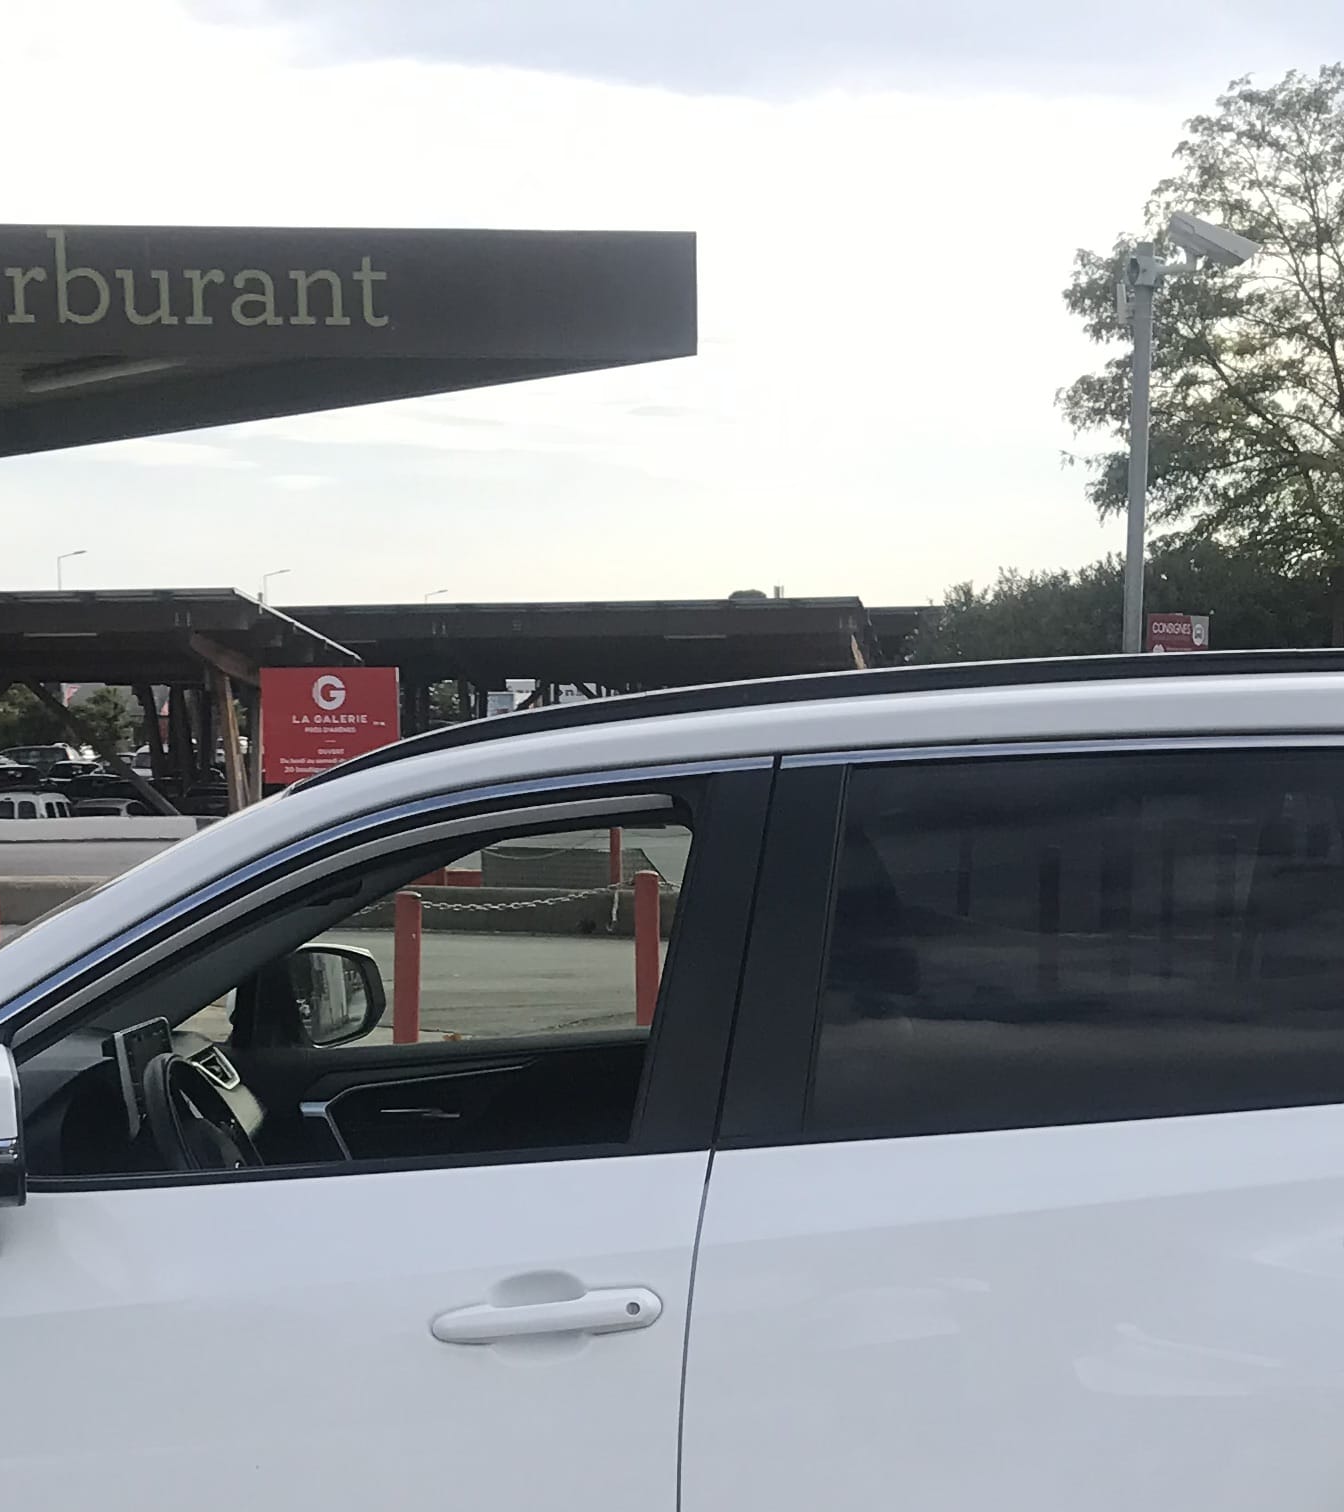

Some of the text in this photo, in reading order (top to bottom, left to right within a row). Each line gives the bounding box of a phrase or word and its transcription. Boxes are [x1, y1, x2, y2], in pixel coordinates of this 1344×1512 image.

[1152, 622, 1192, 635] CONSIGNES
[312, 674, 347, 711] G
[292, 714, 368, 724] LA GALERIE
